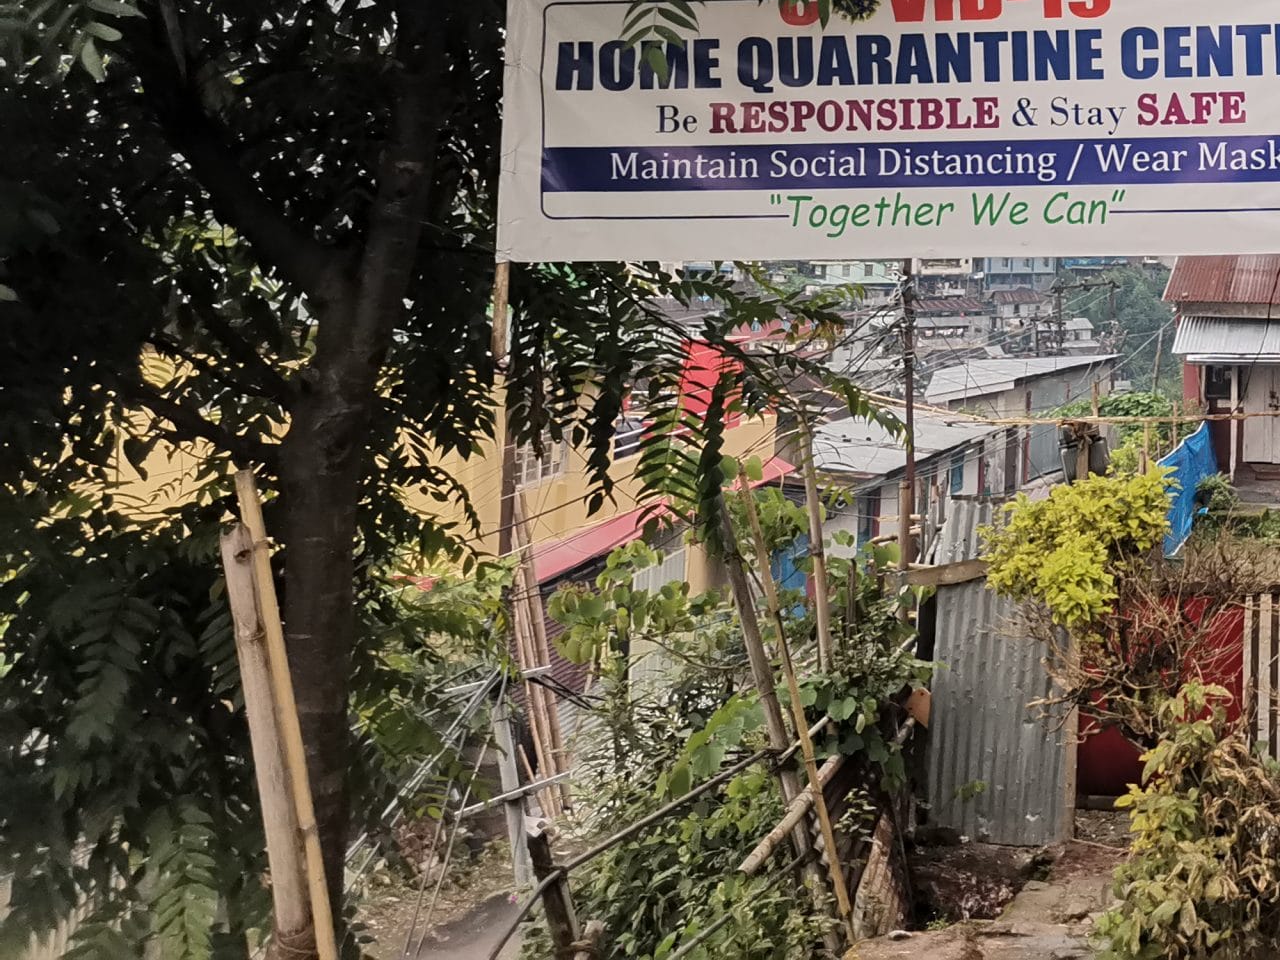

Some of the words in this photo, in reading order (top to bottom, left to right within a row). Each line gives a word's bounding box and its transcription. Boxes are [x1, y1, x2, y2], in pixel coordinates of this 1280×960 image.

[556, 39, 721, 91] HOME
[736, 29, 1104, 93] QUARANTINE
[655, 105, 698, 134] Be
[709, 97, 1000, 133] RESPONSIBLE
[1011, 98, 1038, 127] &
[1049, 96, 1127, 135] Stay
[1137, 91, 1246, 126] SAFE
[610, 151, 759, 180] Maintain
[770, 149, 866, 178] Social
[878, 144, 1057, 181] Distancing
[1094, 143, 1188, 173] Wear
[971, 192, 1029, 226] We
